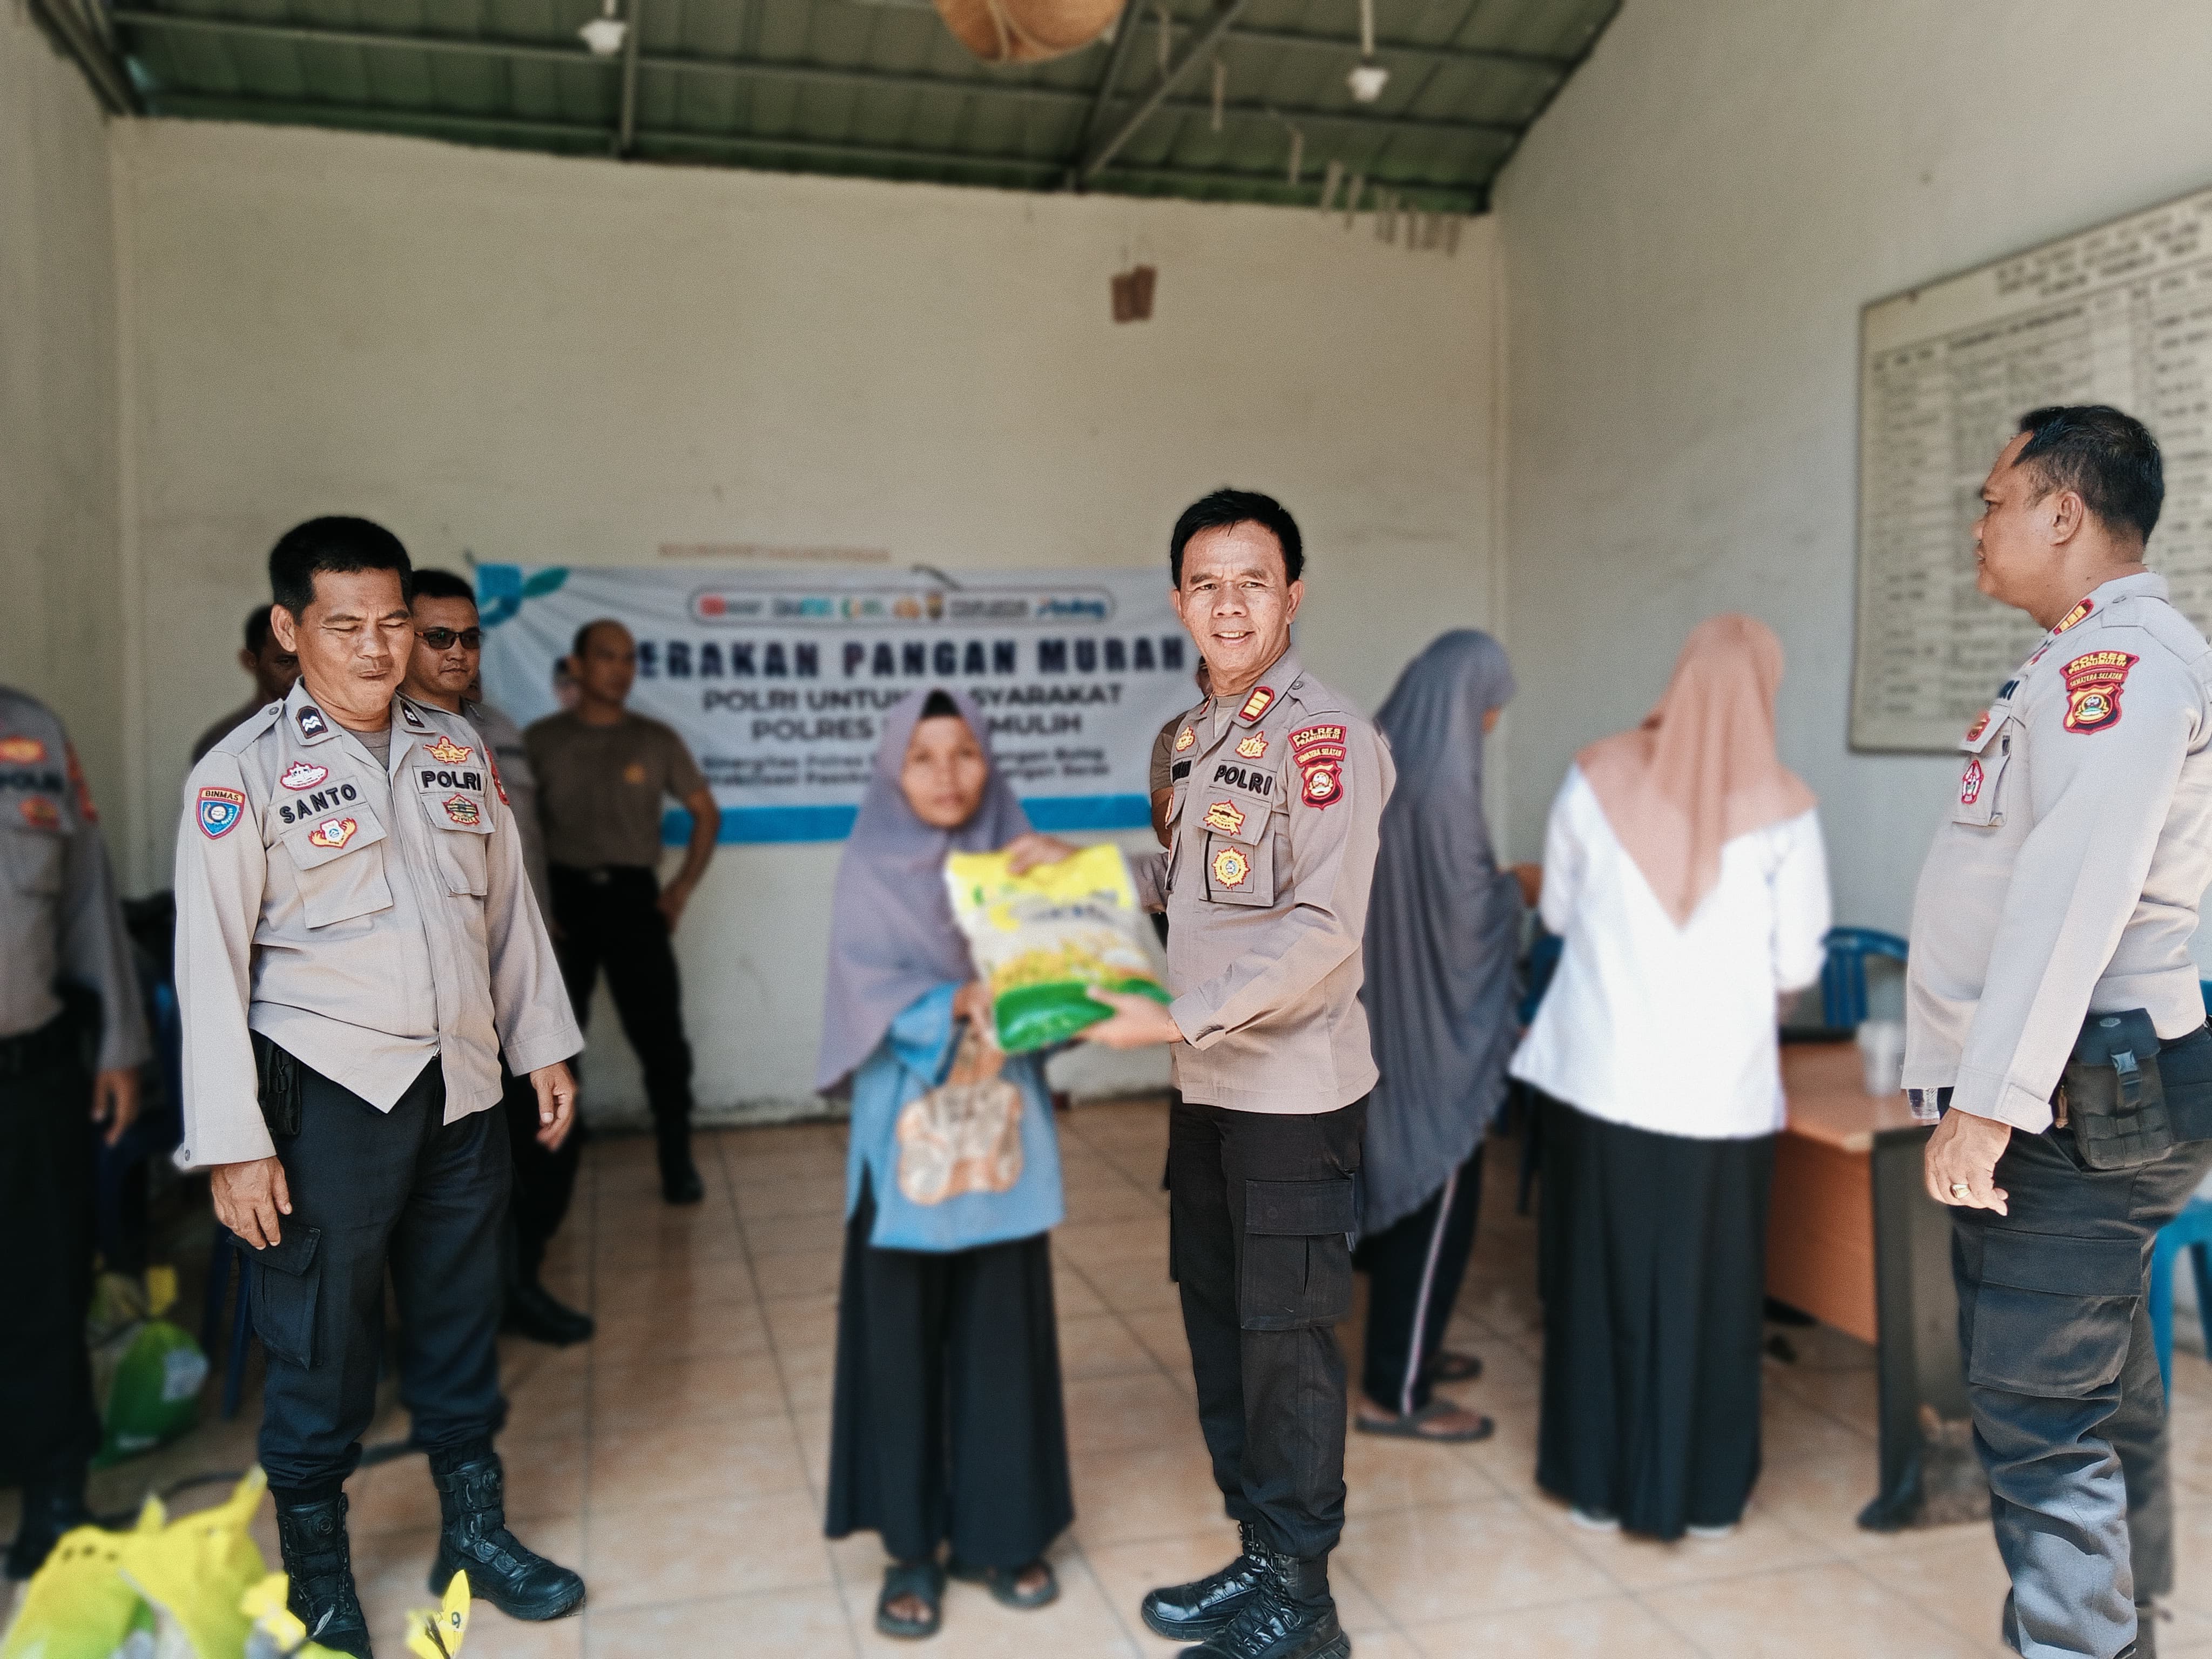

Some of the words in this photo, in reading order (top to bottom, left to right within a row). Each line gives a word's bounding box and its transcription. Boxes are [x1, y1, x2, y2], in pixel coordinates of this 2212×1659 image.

[638, 639, 819, 678] ERAKAN
[843, 639, 1016, 677] PANGAN
[1037, 637, 1184, 674] MURAH
[2071, 652, 2127, 669] POLRES
[2069, 673, 2098, 687] SUMATERA
[2099, 672, 2123, 680] SELATAN
[703, 687, 799, 712] POLRI
[968, 681, 1122, 705] SYARAKAT
[752, 717, 875, 740] POLRES
[987, 712, 1082, 736] MULIH
[1292, 727, 1341, 742] POLRES
[421, 771, 482, 791] POLRI
[1213, 765, 1273, 795] POLRI
[205, 791, 239, 801] BINMAS
[280, 784, 356, 824] SANTO
